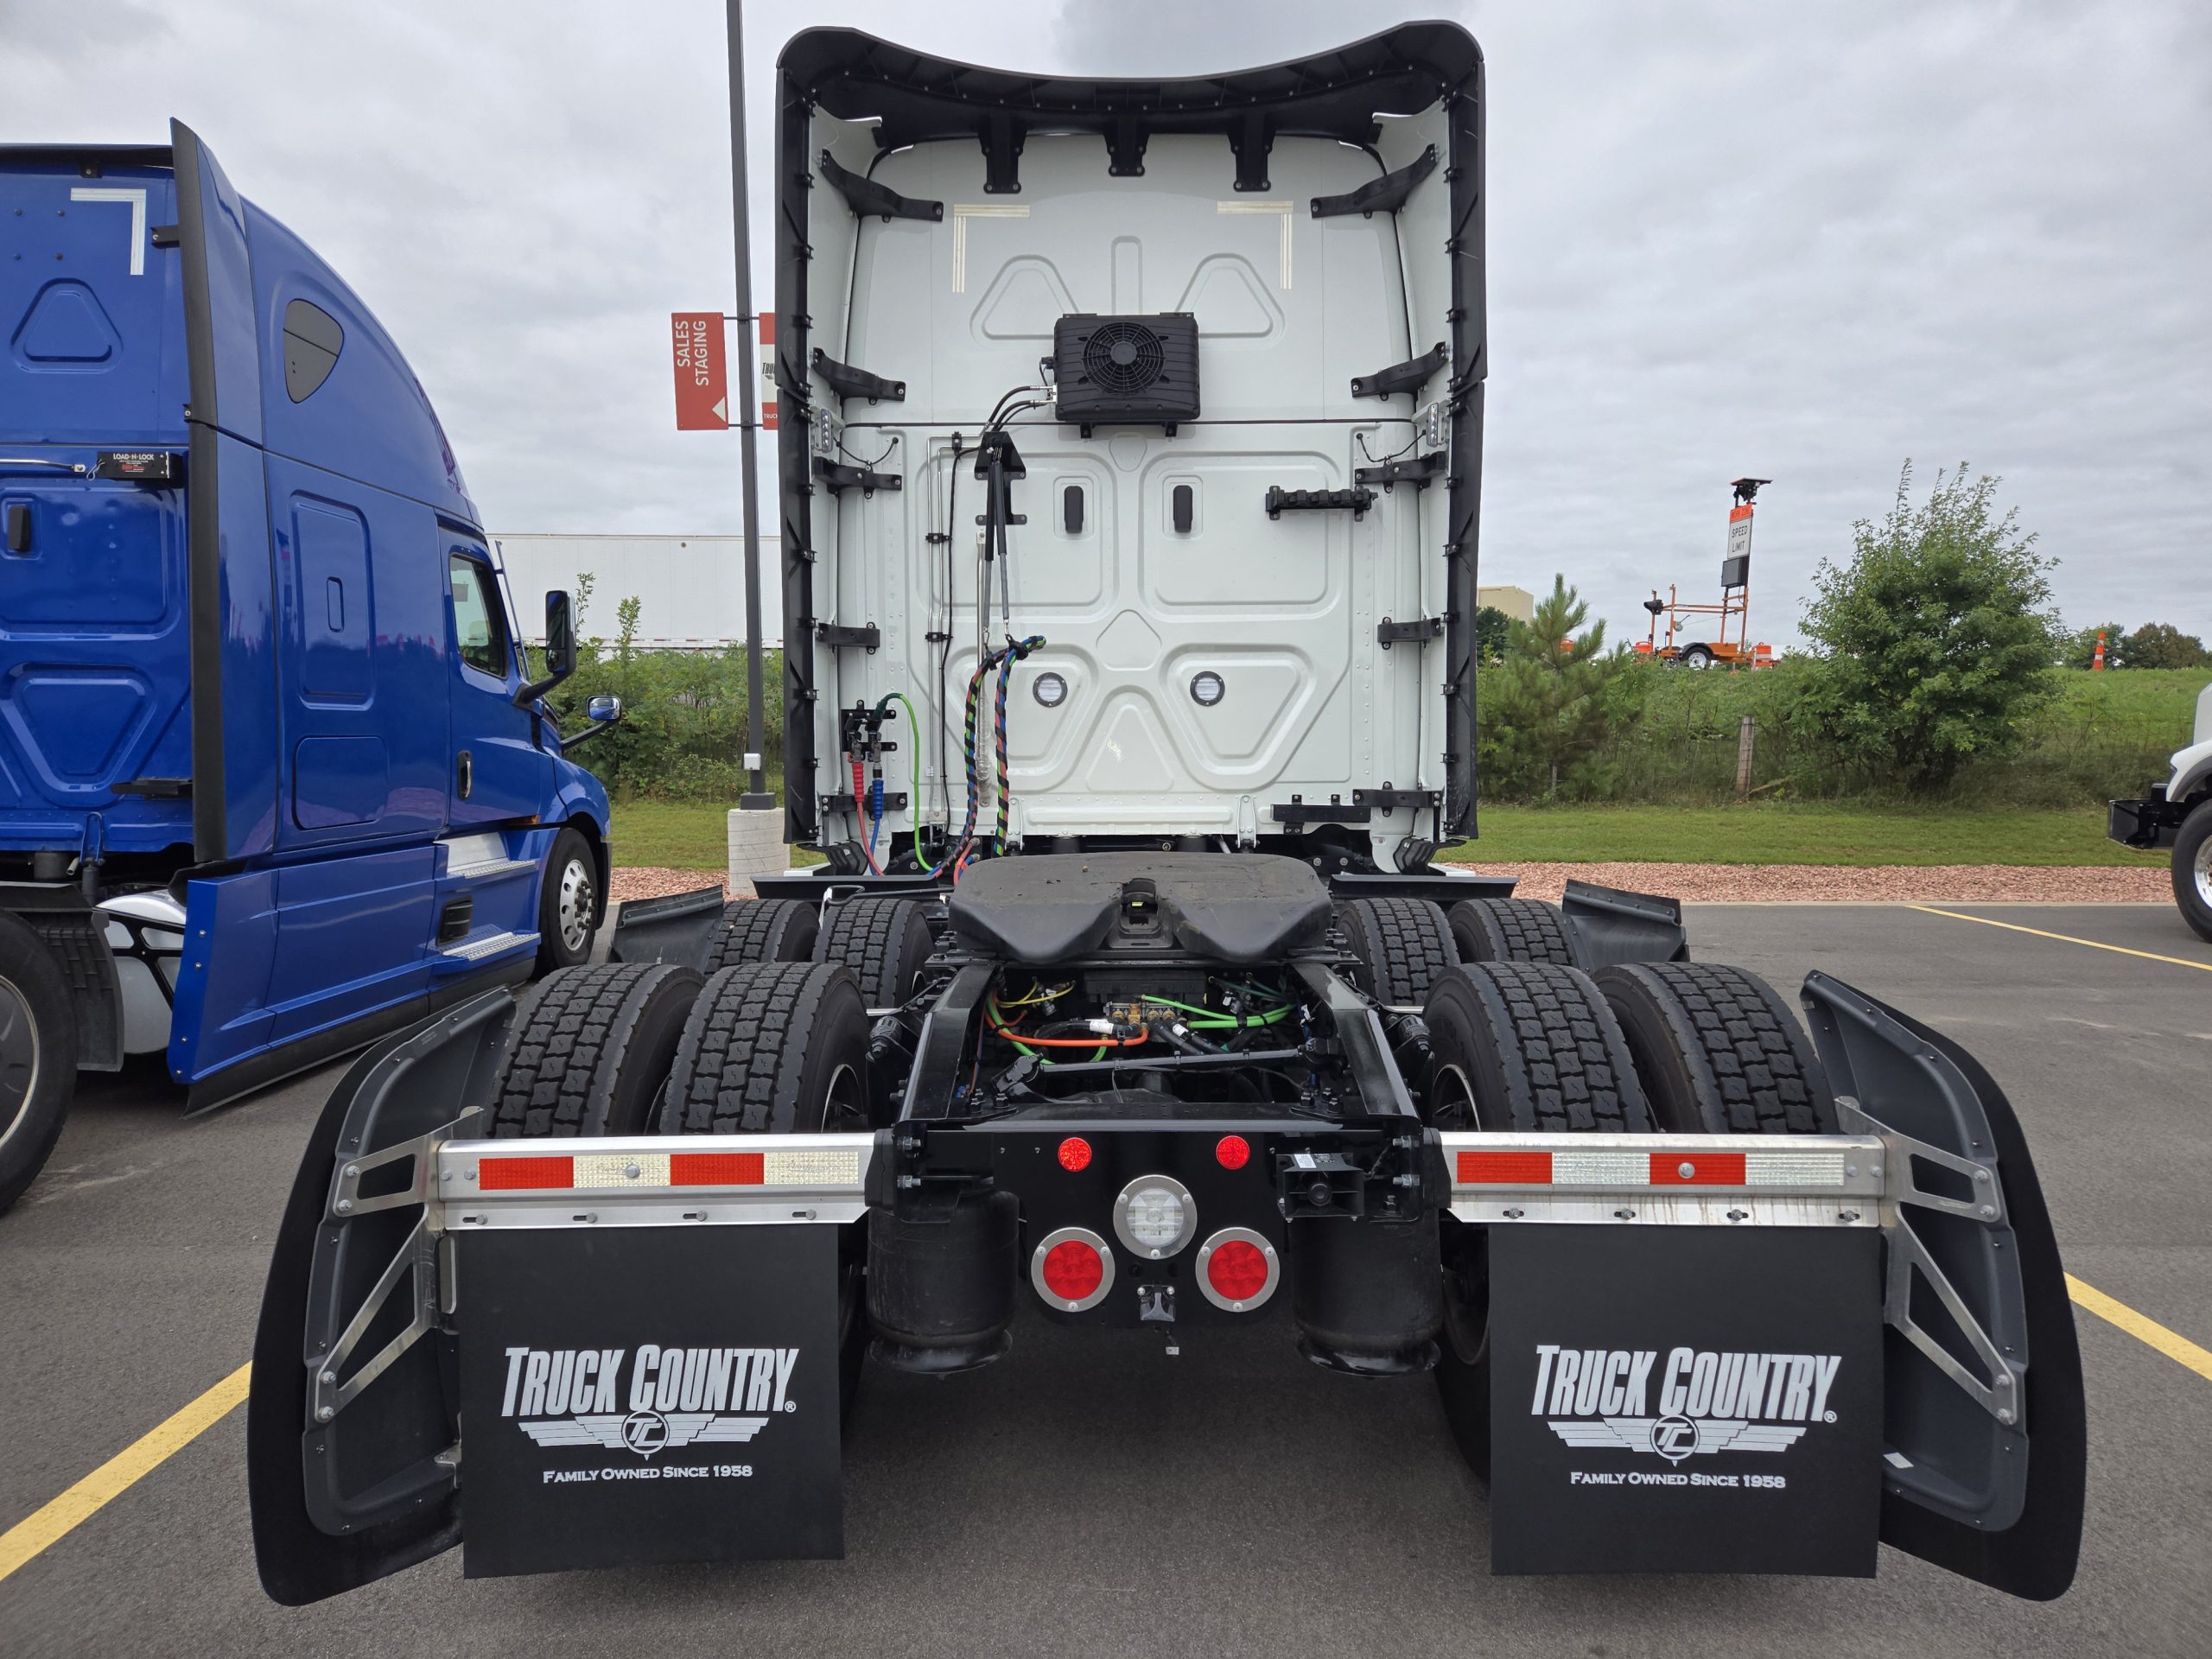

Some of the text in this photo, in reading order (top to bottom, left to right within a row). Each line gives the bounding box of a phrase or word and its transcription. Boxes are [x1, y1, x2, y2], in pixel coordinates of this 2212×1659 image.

[676, 321, 690, 367] SALES
[693, 321, 709, 386] STAGING
[762, 362, 775, 375] TRU
[1732, 525, 1748, 537] SPEED
[1732, 540, 1745, 552] LIMIT
[501, 1346, 626, 1417] TRUCK
[1531, 1344, 1657, 1416] TRUCK
[543, 1465, 753, 1484] FAMILY OWNED SINCE 1958
[1570, 1471, 1786, 1489] FAMILY OWNED SINCE 1958
